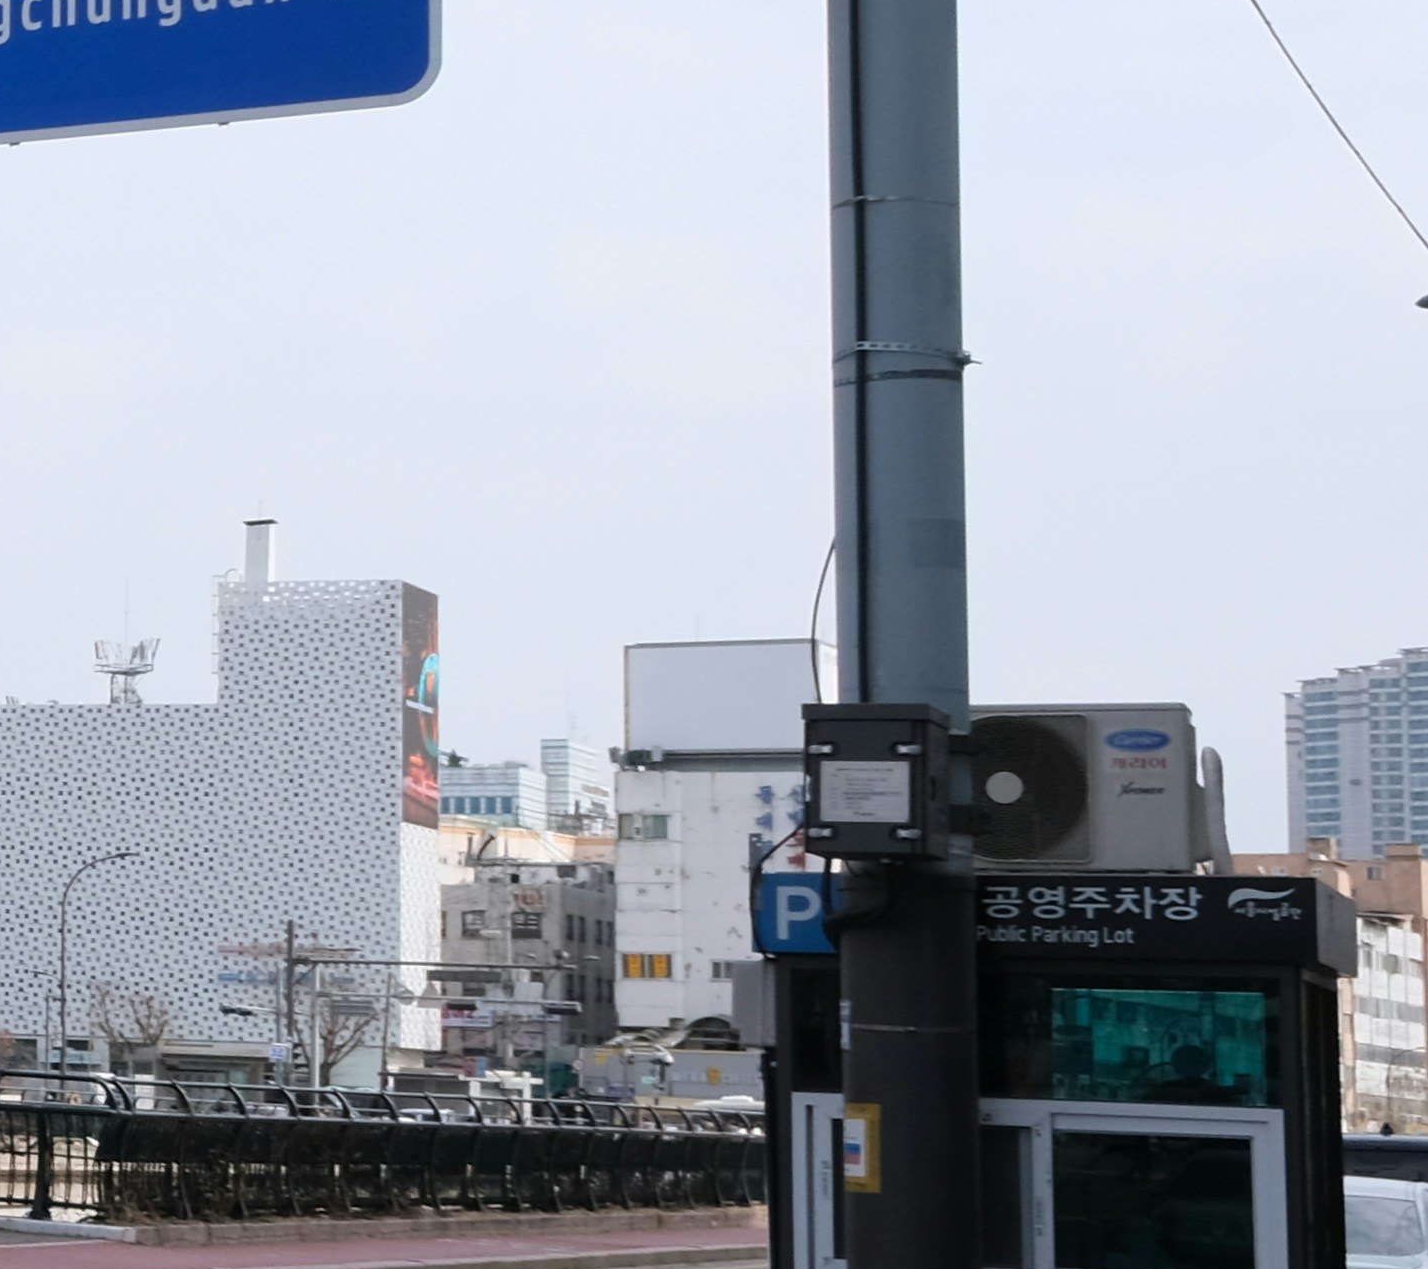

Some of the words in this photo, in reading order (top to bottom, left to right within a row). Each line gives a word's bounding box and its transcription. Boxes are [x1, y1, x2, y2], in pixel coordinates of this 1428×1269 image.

[776, 885, 822, 941] P
[981, 885, 1203, 921] 공영주차장
[977, 925, 1027, 943] Public
[1031, 925, 1099, 948] Parking
[1103, 927, 1135, 944] Lot
